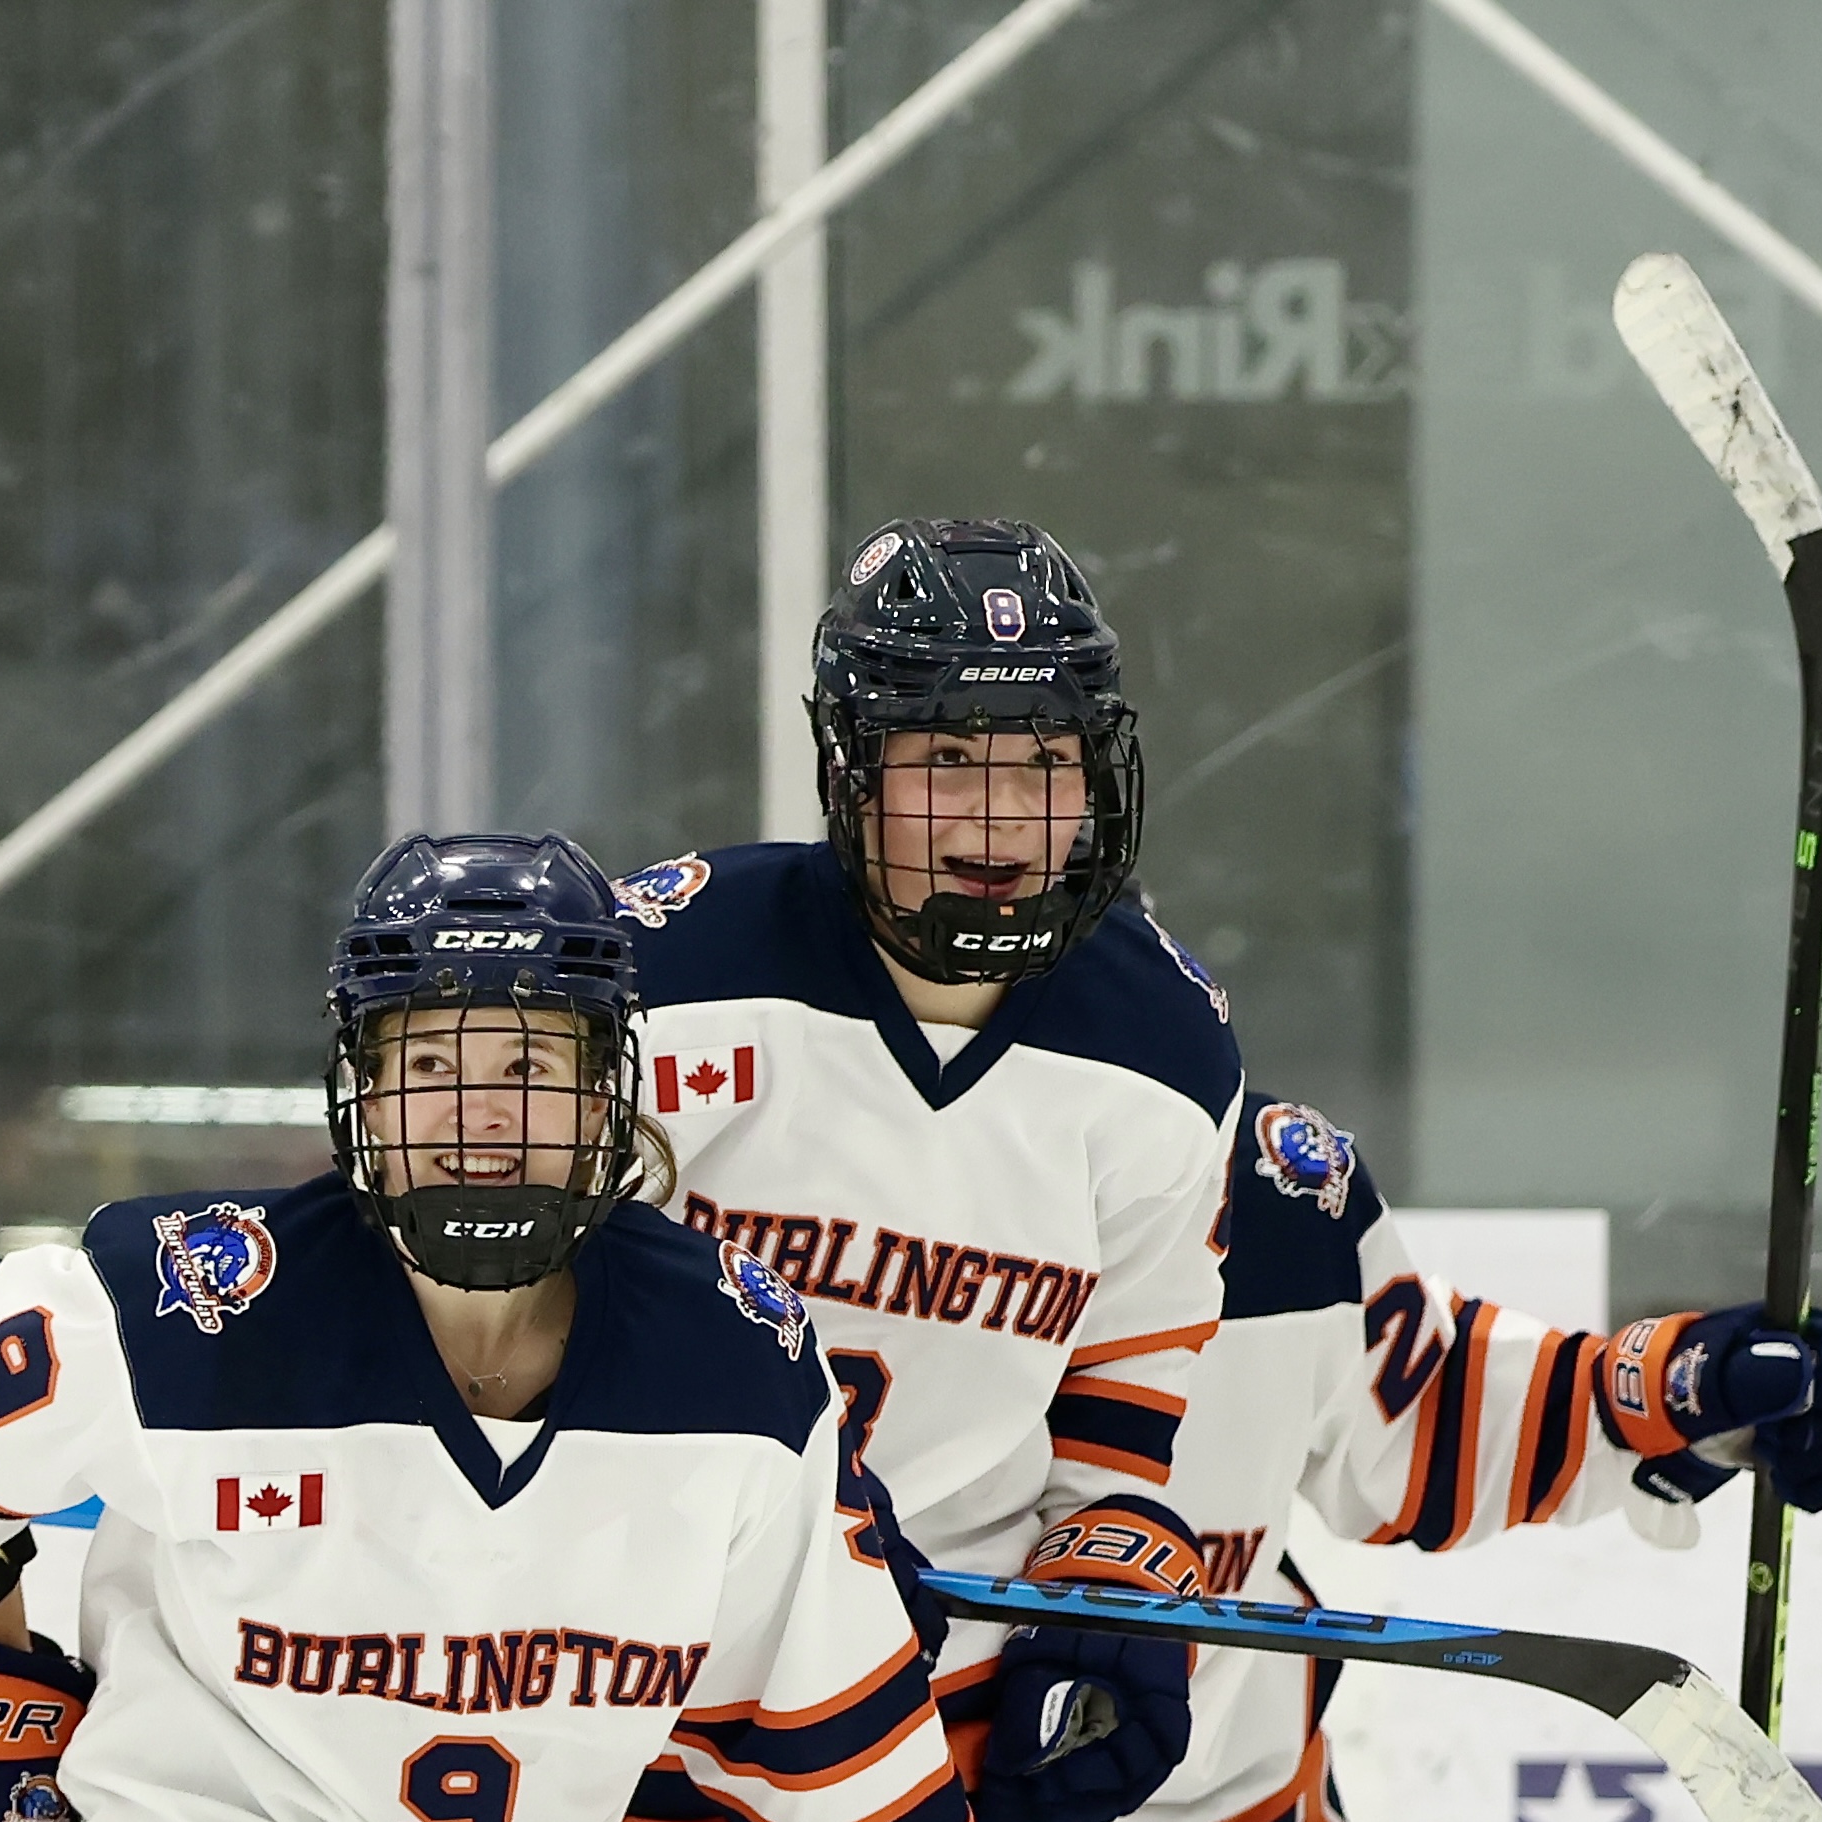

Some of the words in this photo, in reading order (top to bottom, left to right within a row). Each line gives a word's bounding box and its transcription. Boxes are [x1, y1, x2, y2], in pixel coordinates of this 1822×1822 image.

[982, 588, 1026, 642] 8
[958, 665, 1056, 684] BAUER
[431, 929, 547, 951] CCM
[951, 929, 1053, 953] CCM
[441, 1219, 537, 1240] CCM
[1029, 1522, 1205, 1598] BAU
[233, 1616, 711, 1715] BURLINGTON
